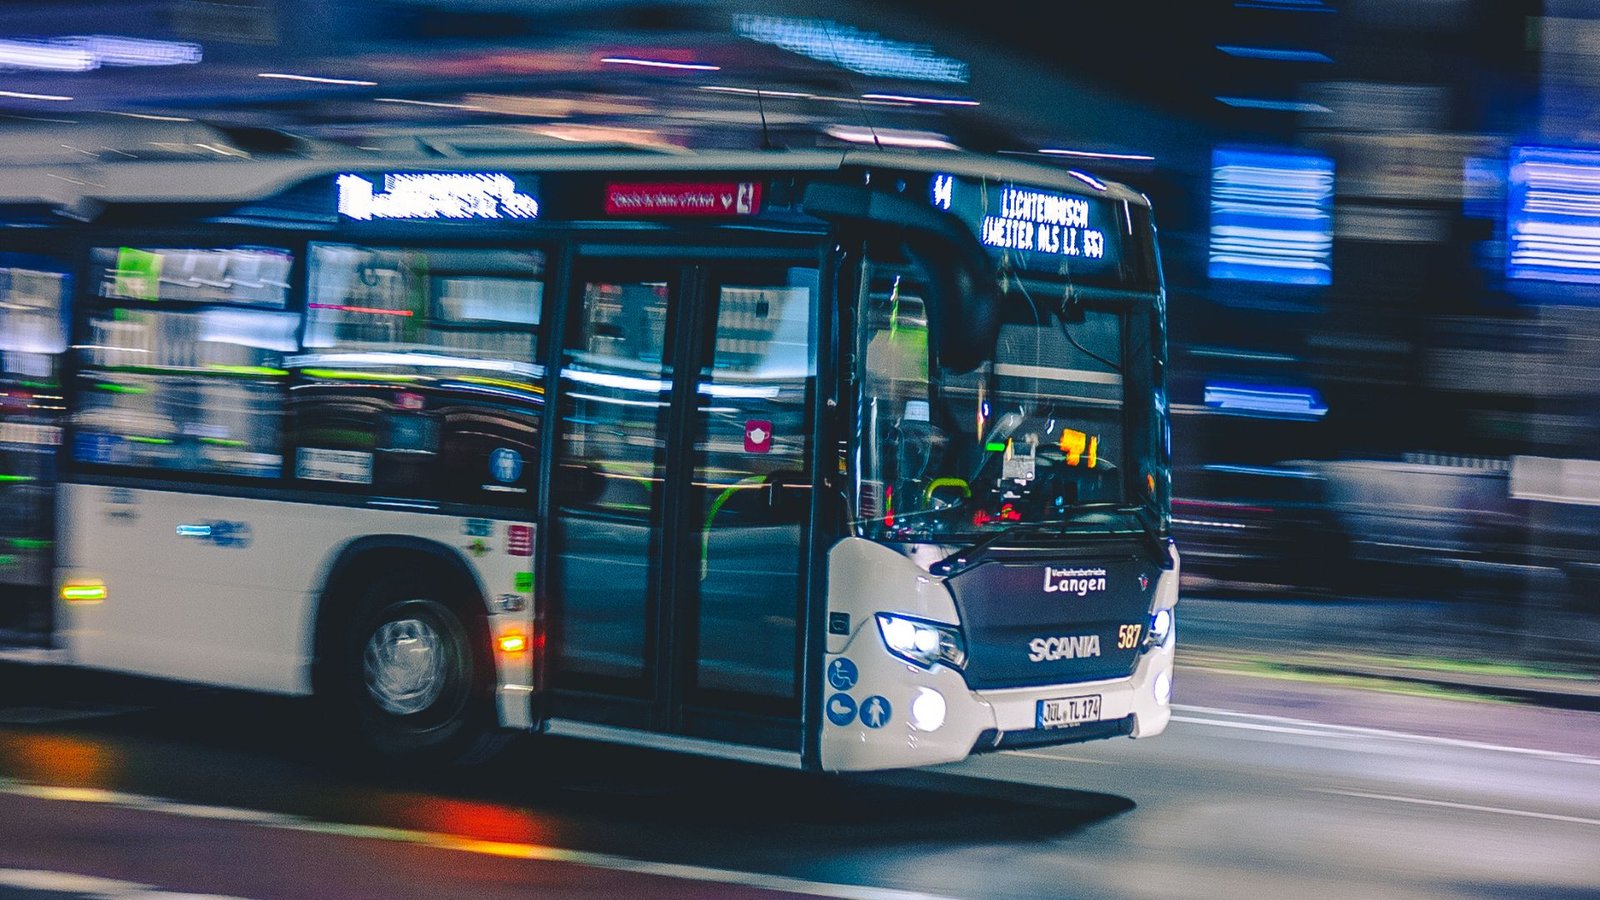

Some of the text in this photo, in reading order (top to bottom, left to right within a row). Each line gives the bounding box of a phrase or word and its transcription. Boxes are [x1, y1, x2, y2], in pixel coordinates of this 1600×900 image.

[1043, 566, 1106, 596] Langen
[1052, 568, 1106, 577] Verkehrsbetriebe
[1028, 635, 1101, 662] SCANIA
[1117, 624, 1142, 649] 587
[1069, 701, 1080, 720] TL
[1082, 699, 1099, 718] 174
